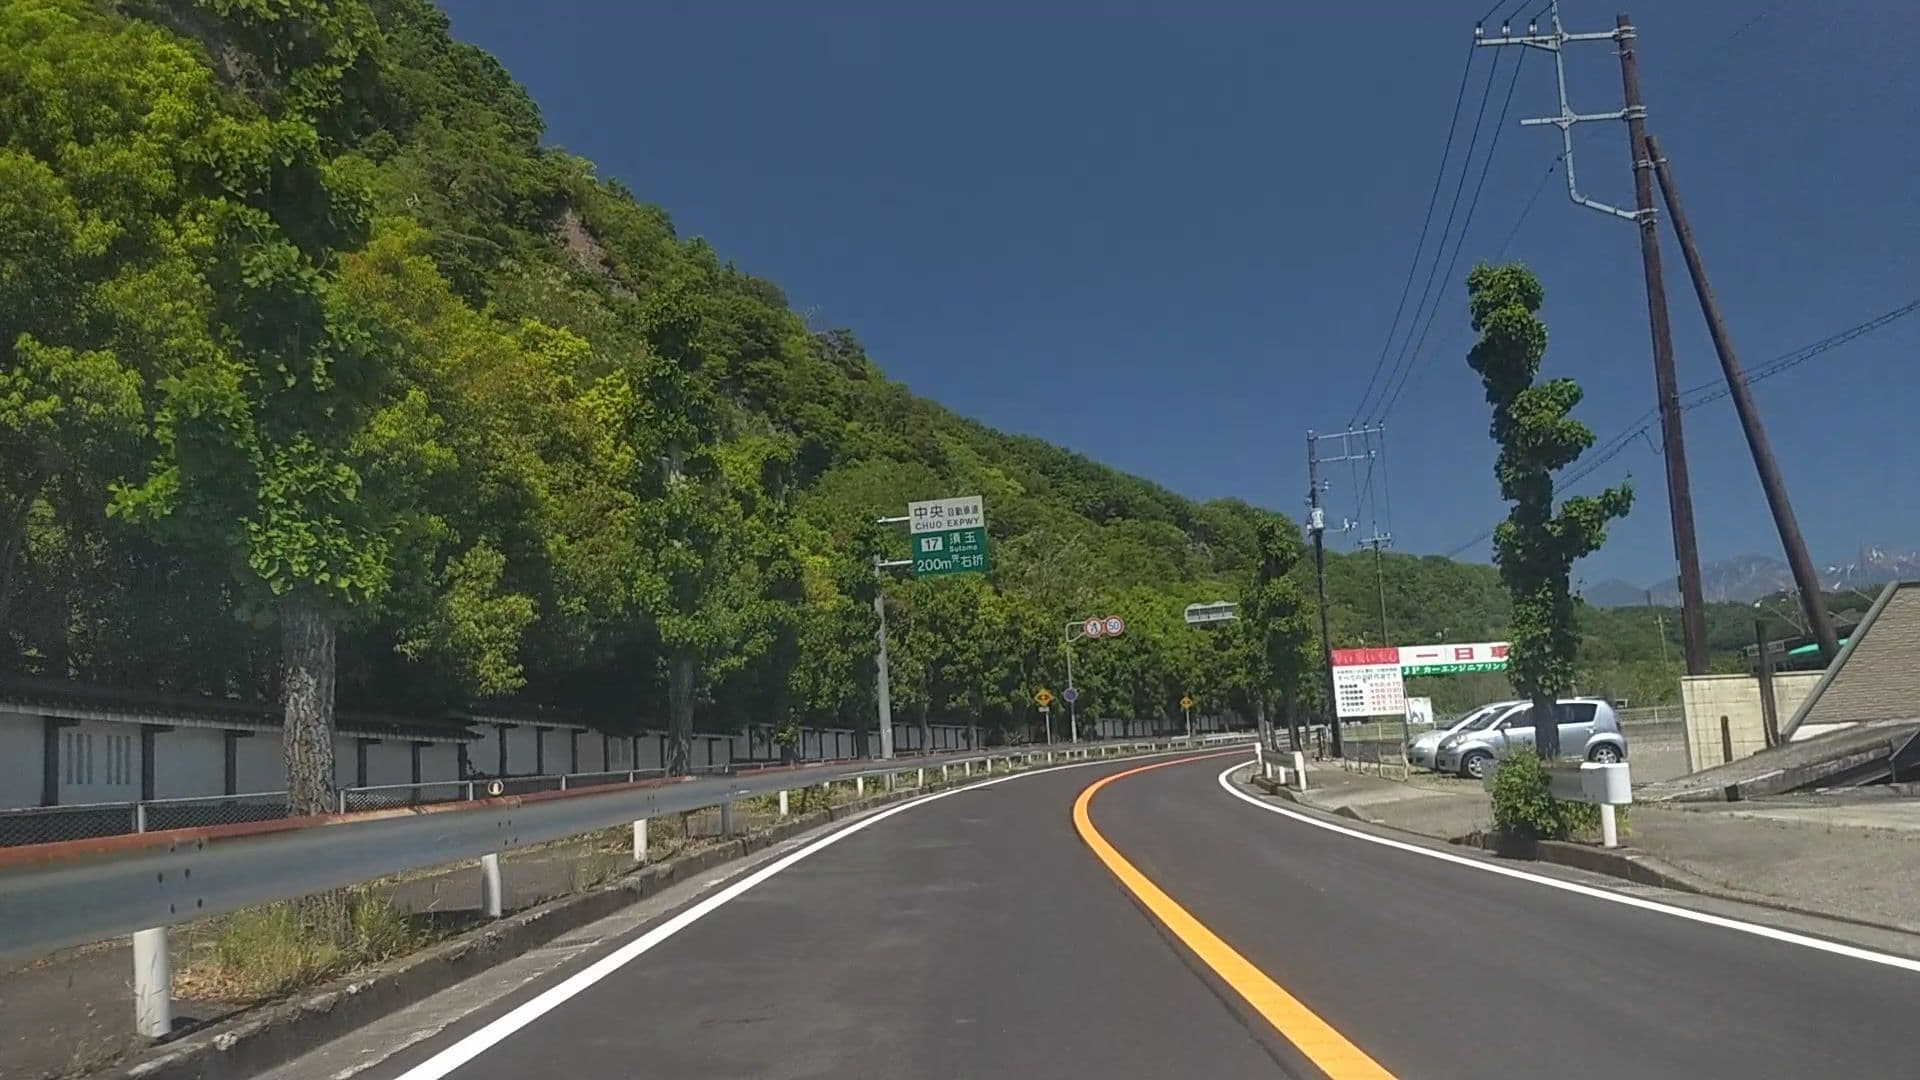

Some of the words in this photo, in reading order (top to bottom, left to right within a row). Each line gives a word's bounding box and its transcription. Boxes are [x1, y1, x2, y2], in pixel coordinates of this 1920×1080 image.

[914, 504, 944, 519] 中央
[915, 520, 943, 530] CHUO
[947, 517, 980, 527] EXPWY
[925, 538, 938, 550] 17
[1108, 621, 1119, 630] 50
